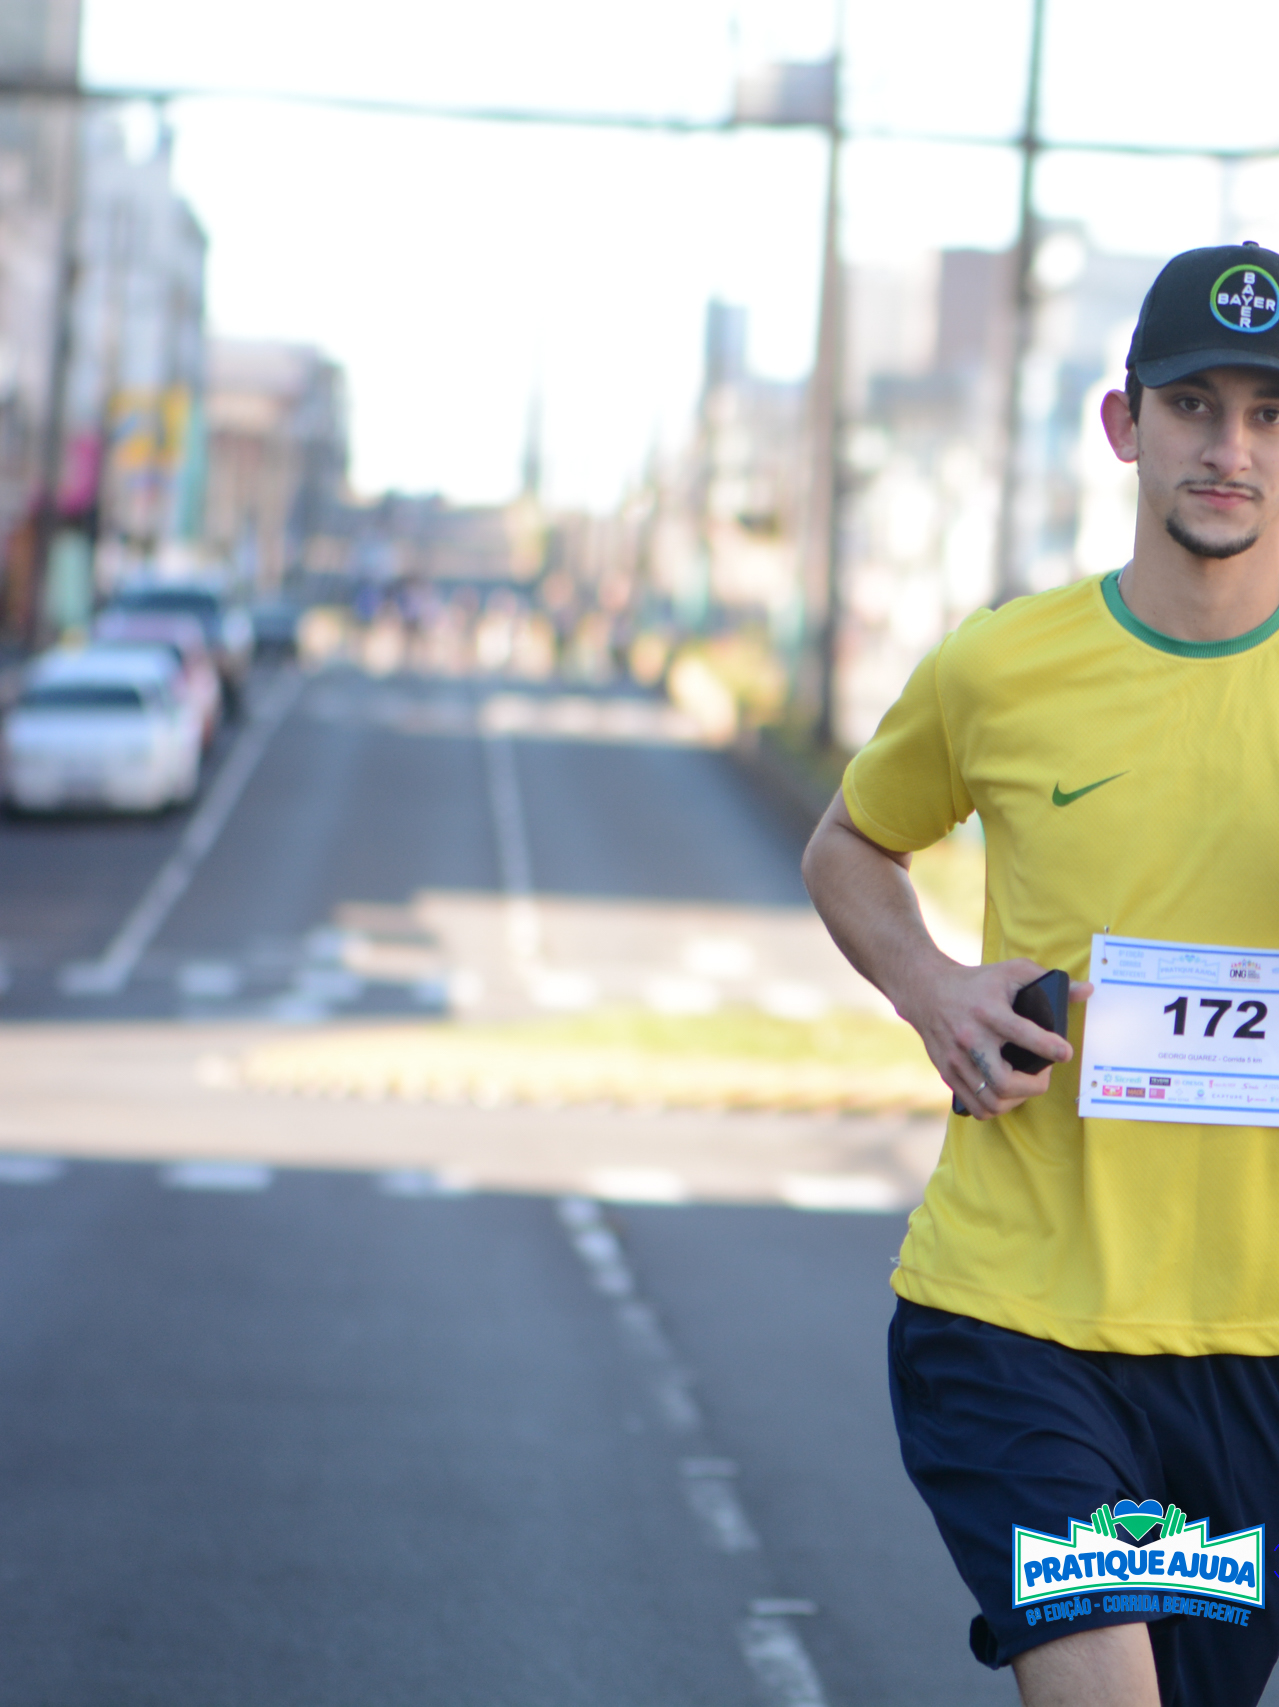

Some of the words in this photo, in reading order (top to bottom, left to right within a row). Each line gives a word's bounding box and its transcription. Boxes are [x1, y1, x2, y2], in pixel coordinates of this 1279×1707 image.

[1217, 292, 1276, 312] BAYER
[1240, 271, 1255, 328] BAYER
[1160, 966, 1194, 974] PRATIQUE
[1230, 968, 1246, 978] ONG
[1163, 996, 1268, 1039] 172
[1222, 1055, 1246, 1063] Corrida
[1246, 1056, 1252, 1064] 5
[1252, 1056, 1262, 1064] km
[1114, 1074, 1142, 1084] Sicredi
